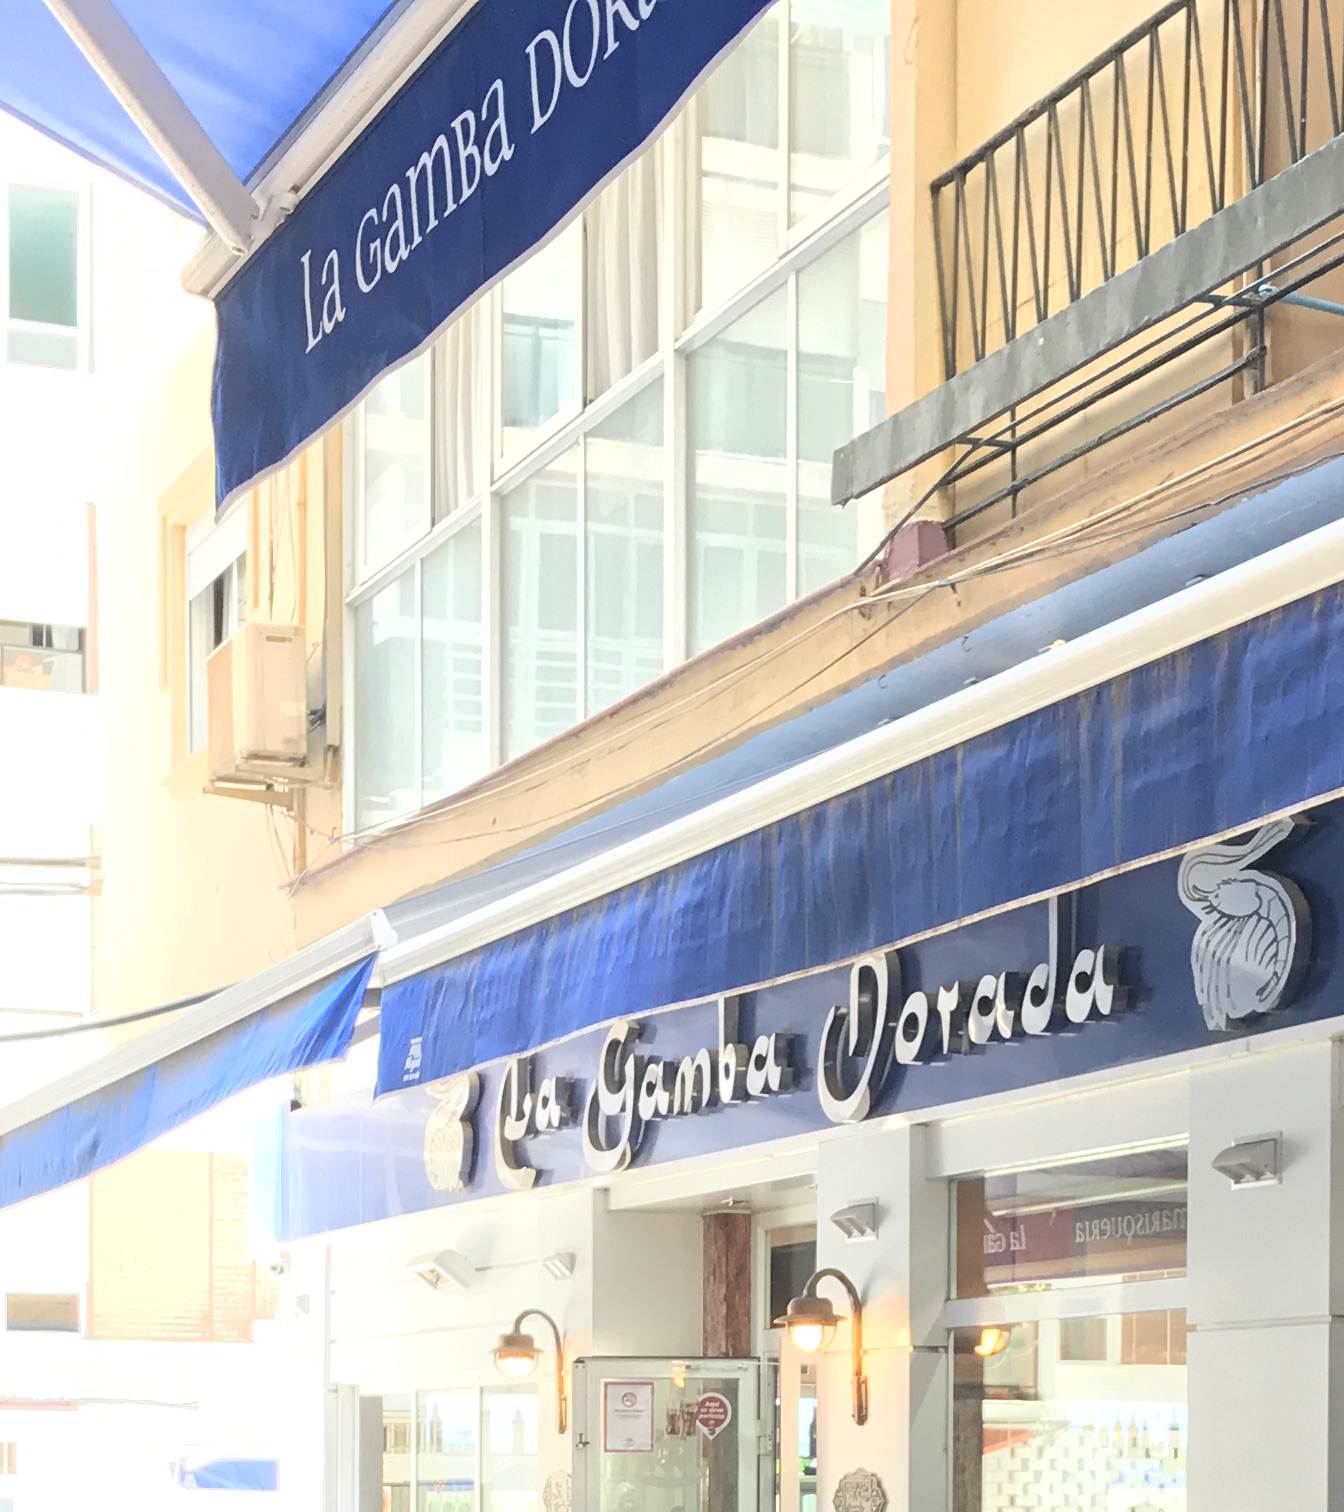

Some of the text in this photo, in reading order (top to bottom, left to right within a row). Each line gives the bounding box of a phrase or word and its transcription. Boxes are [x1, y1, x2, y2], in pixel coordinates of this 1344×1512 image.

[495, 897, 1115, 1191] La Gamba Dorada
